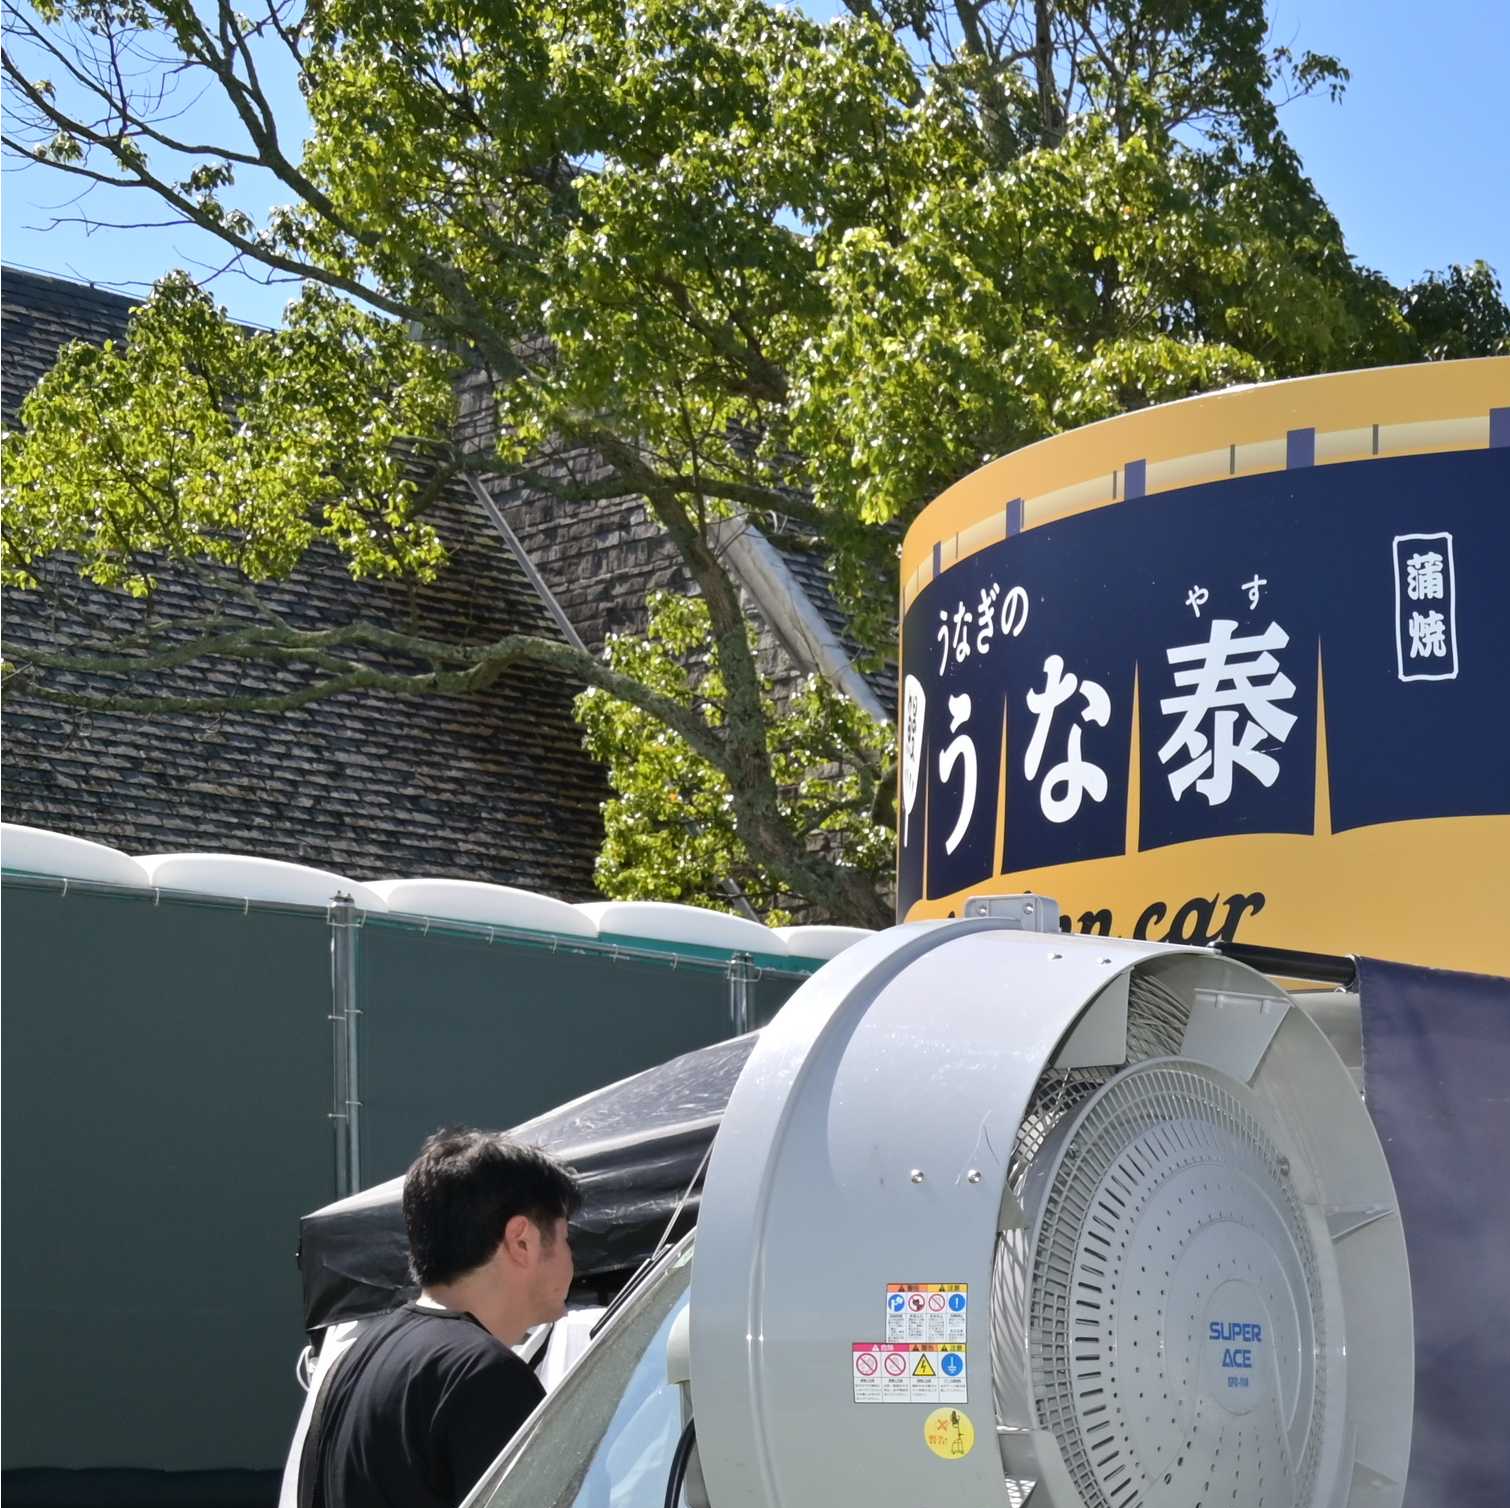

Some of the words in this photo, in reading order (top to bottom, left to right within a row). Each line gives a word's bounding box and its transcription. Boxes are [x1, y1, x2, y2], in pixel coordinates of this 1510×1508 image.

[937, 582, 1029, 677] うなぎの
[1186, 574, 1268, 617] やす
[1406, 551, 1447, 658] 蒲焼
[938, 619, 1299, 857] うな泰
[1209, 1322, 1263, 1342] SUPER
[1222, 1348, 1252, 1368] ACE
